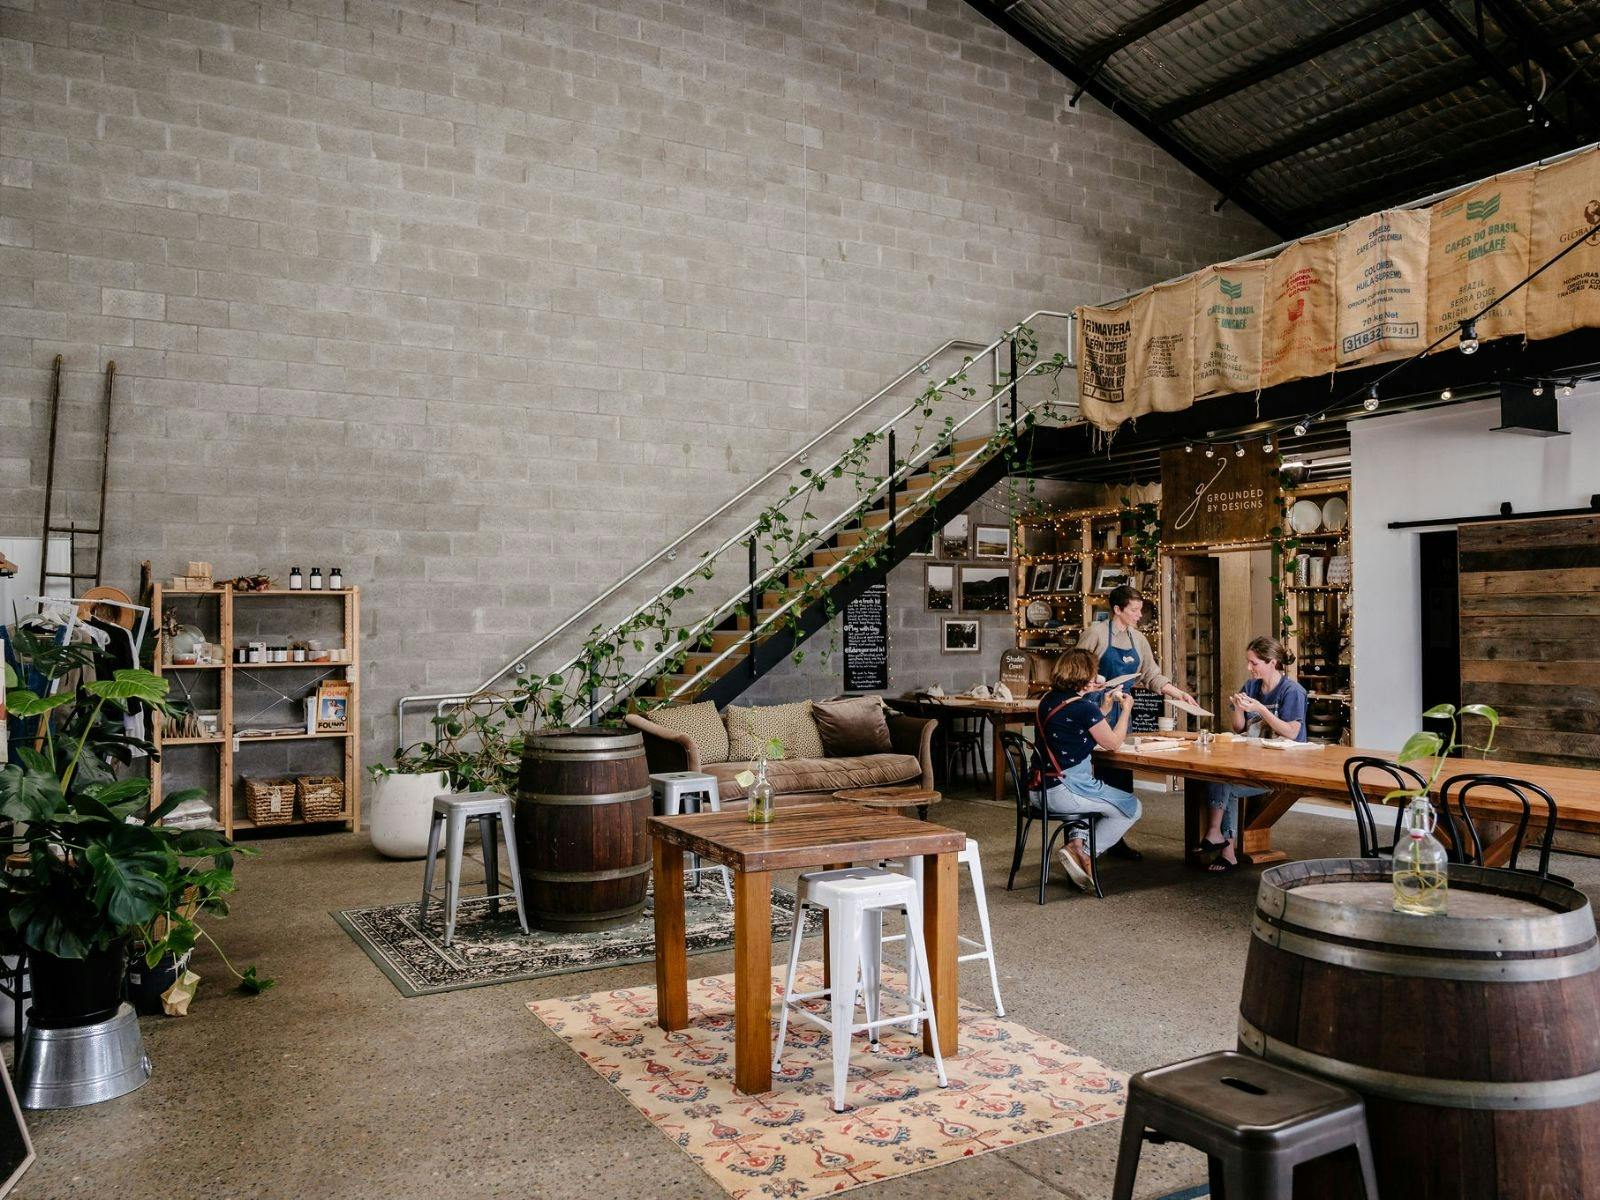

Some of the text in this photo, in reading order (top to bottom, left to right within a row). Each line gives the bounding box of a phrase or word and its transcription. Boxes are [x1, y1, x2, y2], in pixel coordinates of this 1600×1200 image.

[1474, 230, 1486, 242] DO
[1488, 222, 1519, 235] BRASIL
[1375, 270, 1402, 282] SUPREMO
[1563, 272, 1599, 284] HONDURAS
[1459, 279, 1487, 294] BRAZIL
[1450, 287, 1496, 308] SERRA DOCE
[1441, 307, 1468, 321] ORIGIN
[1362, 317, 1372, 327] 70
[1105, 340, 1127, 353] COFFEE
[1346, 339, 1353, 350] 3
[1206, 488, 1264, 503] GROUNDED
[1207, 500, 1263, 513] BY DESIGNS
